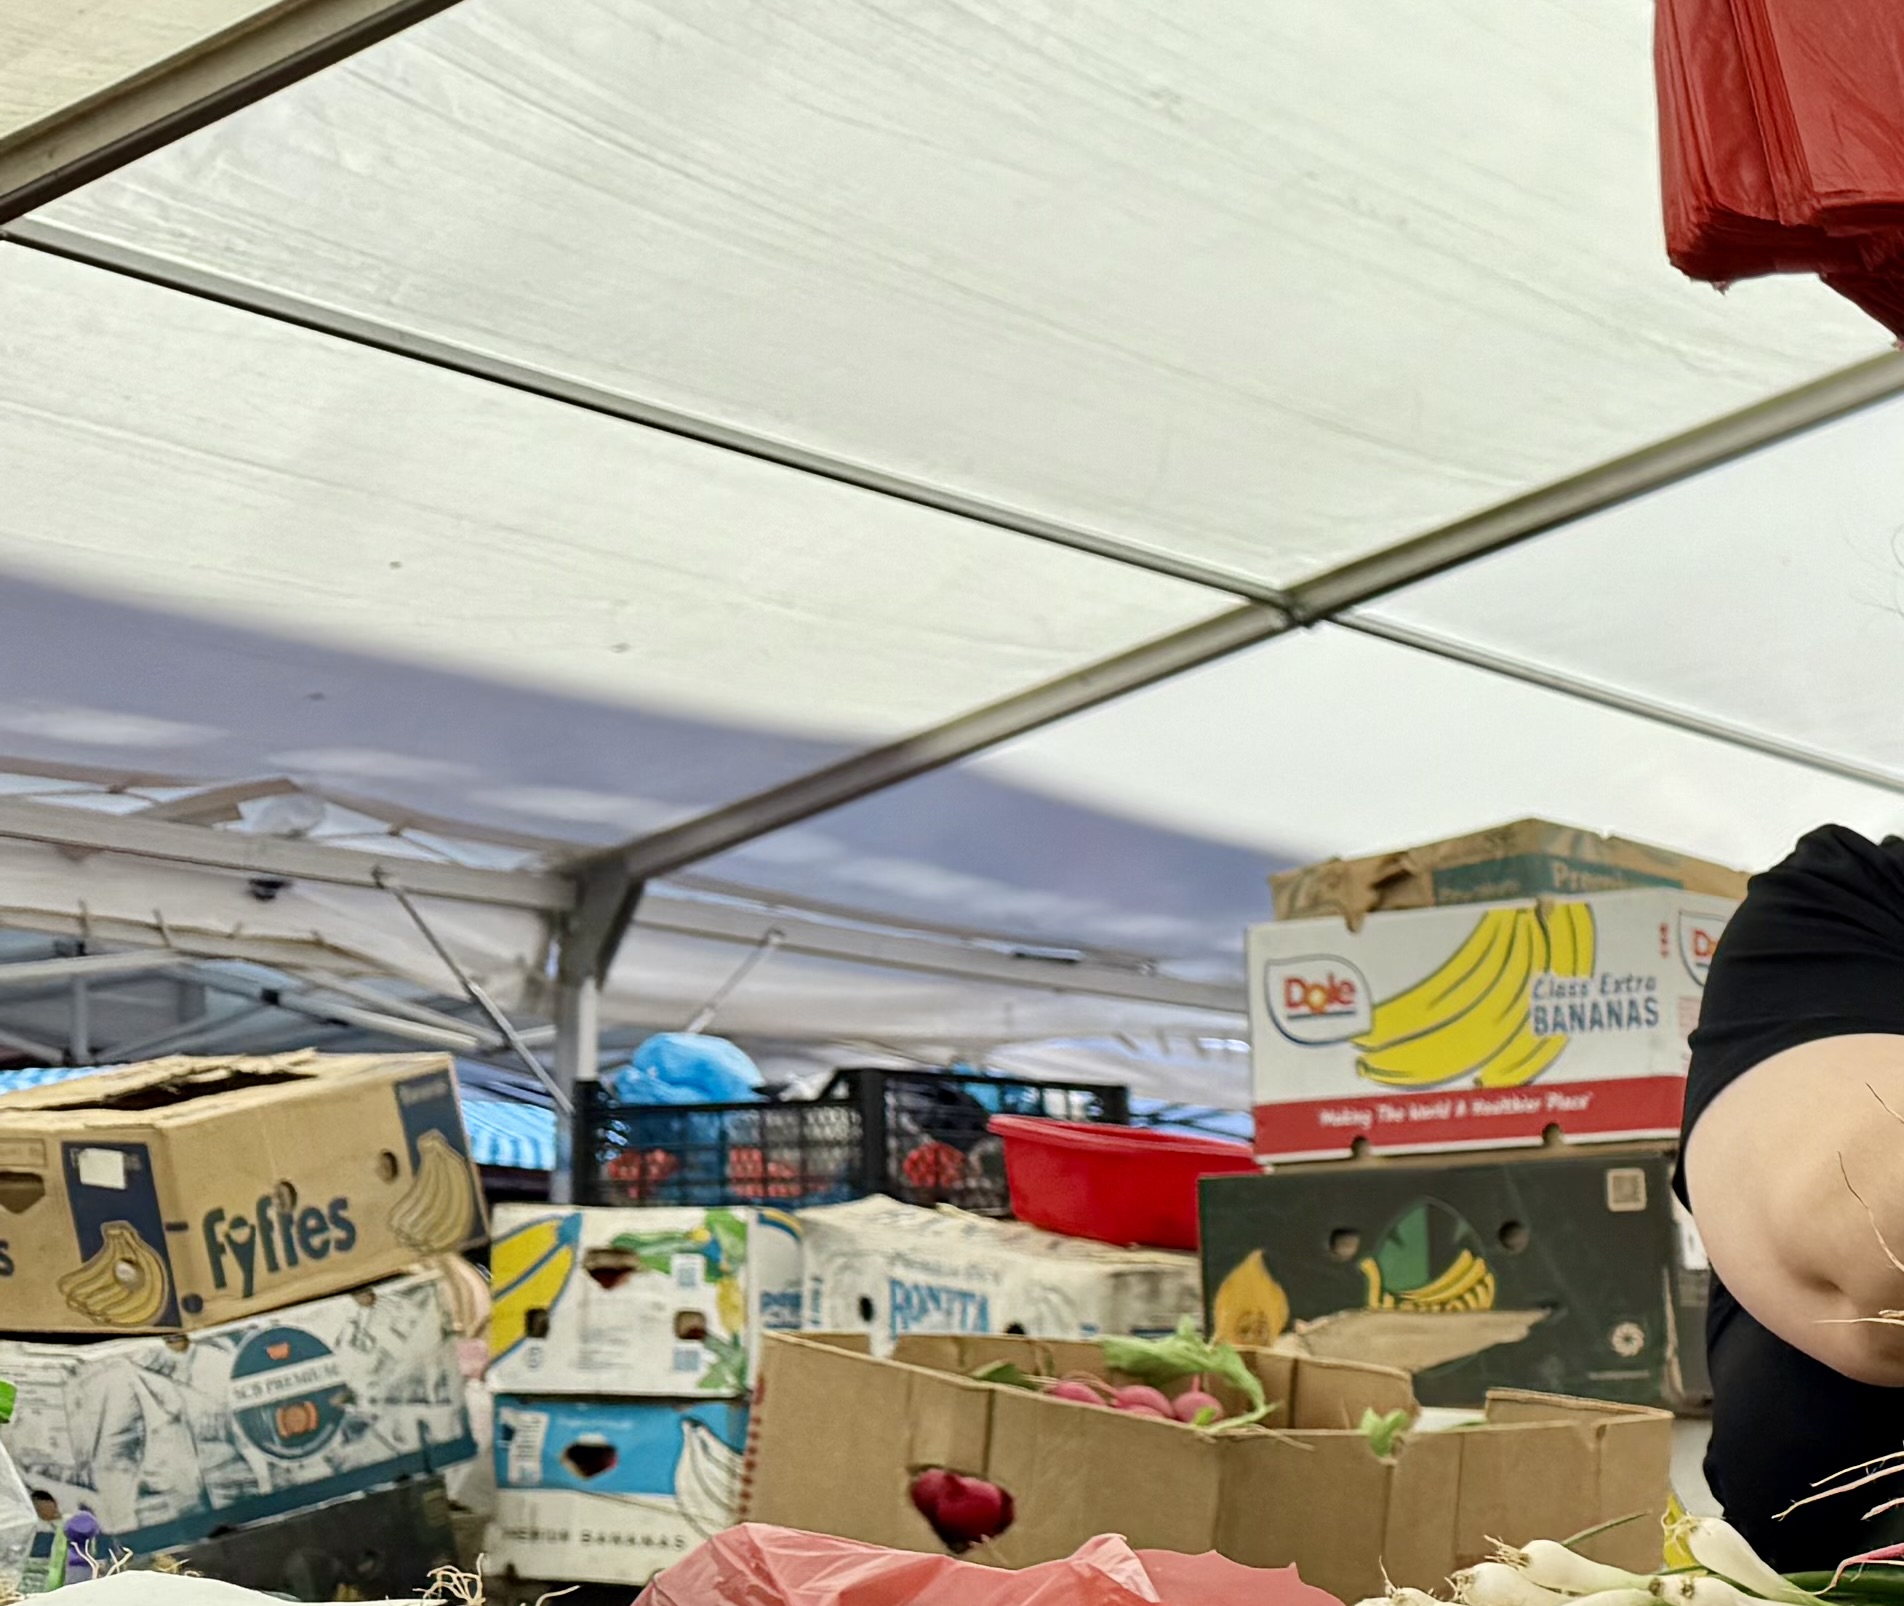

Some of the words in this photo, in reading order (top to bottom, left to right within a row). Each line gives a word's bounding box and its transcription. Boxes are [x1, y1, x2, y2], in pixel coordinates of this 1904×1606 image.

[1282, 971, 1358, 1015] Dole
[1532, 974, 1589, 999] Class
[1598, 972, 1658, 995] Extra
[1532, 995, 1660, 1036] BANANAS
[1377, 1103, 1405, 1122] The
